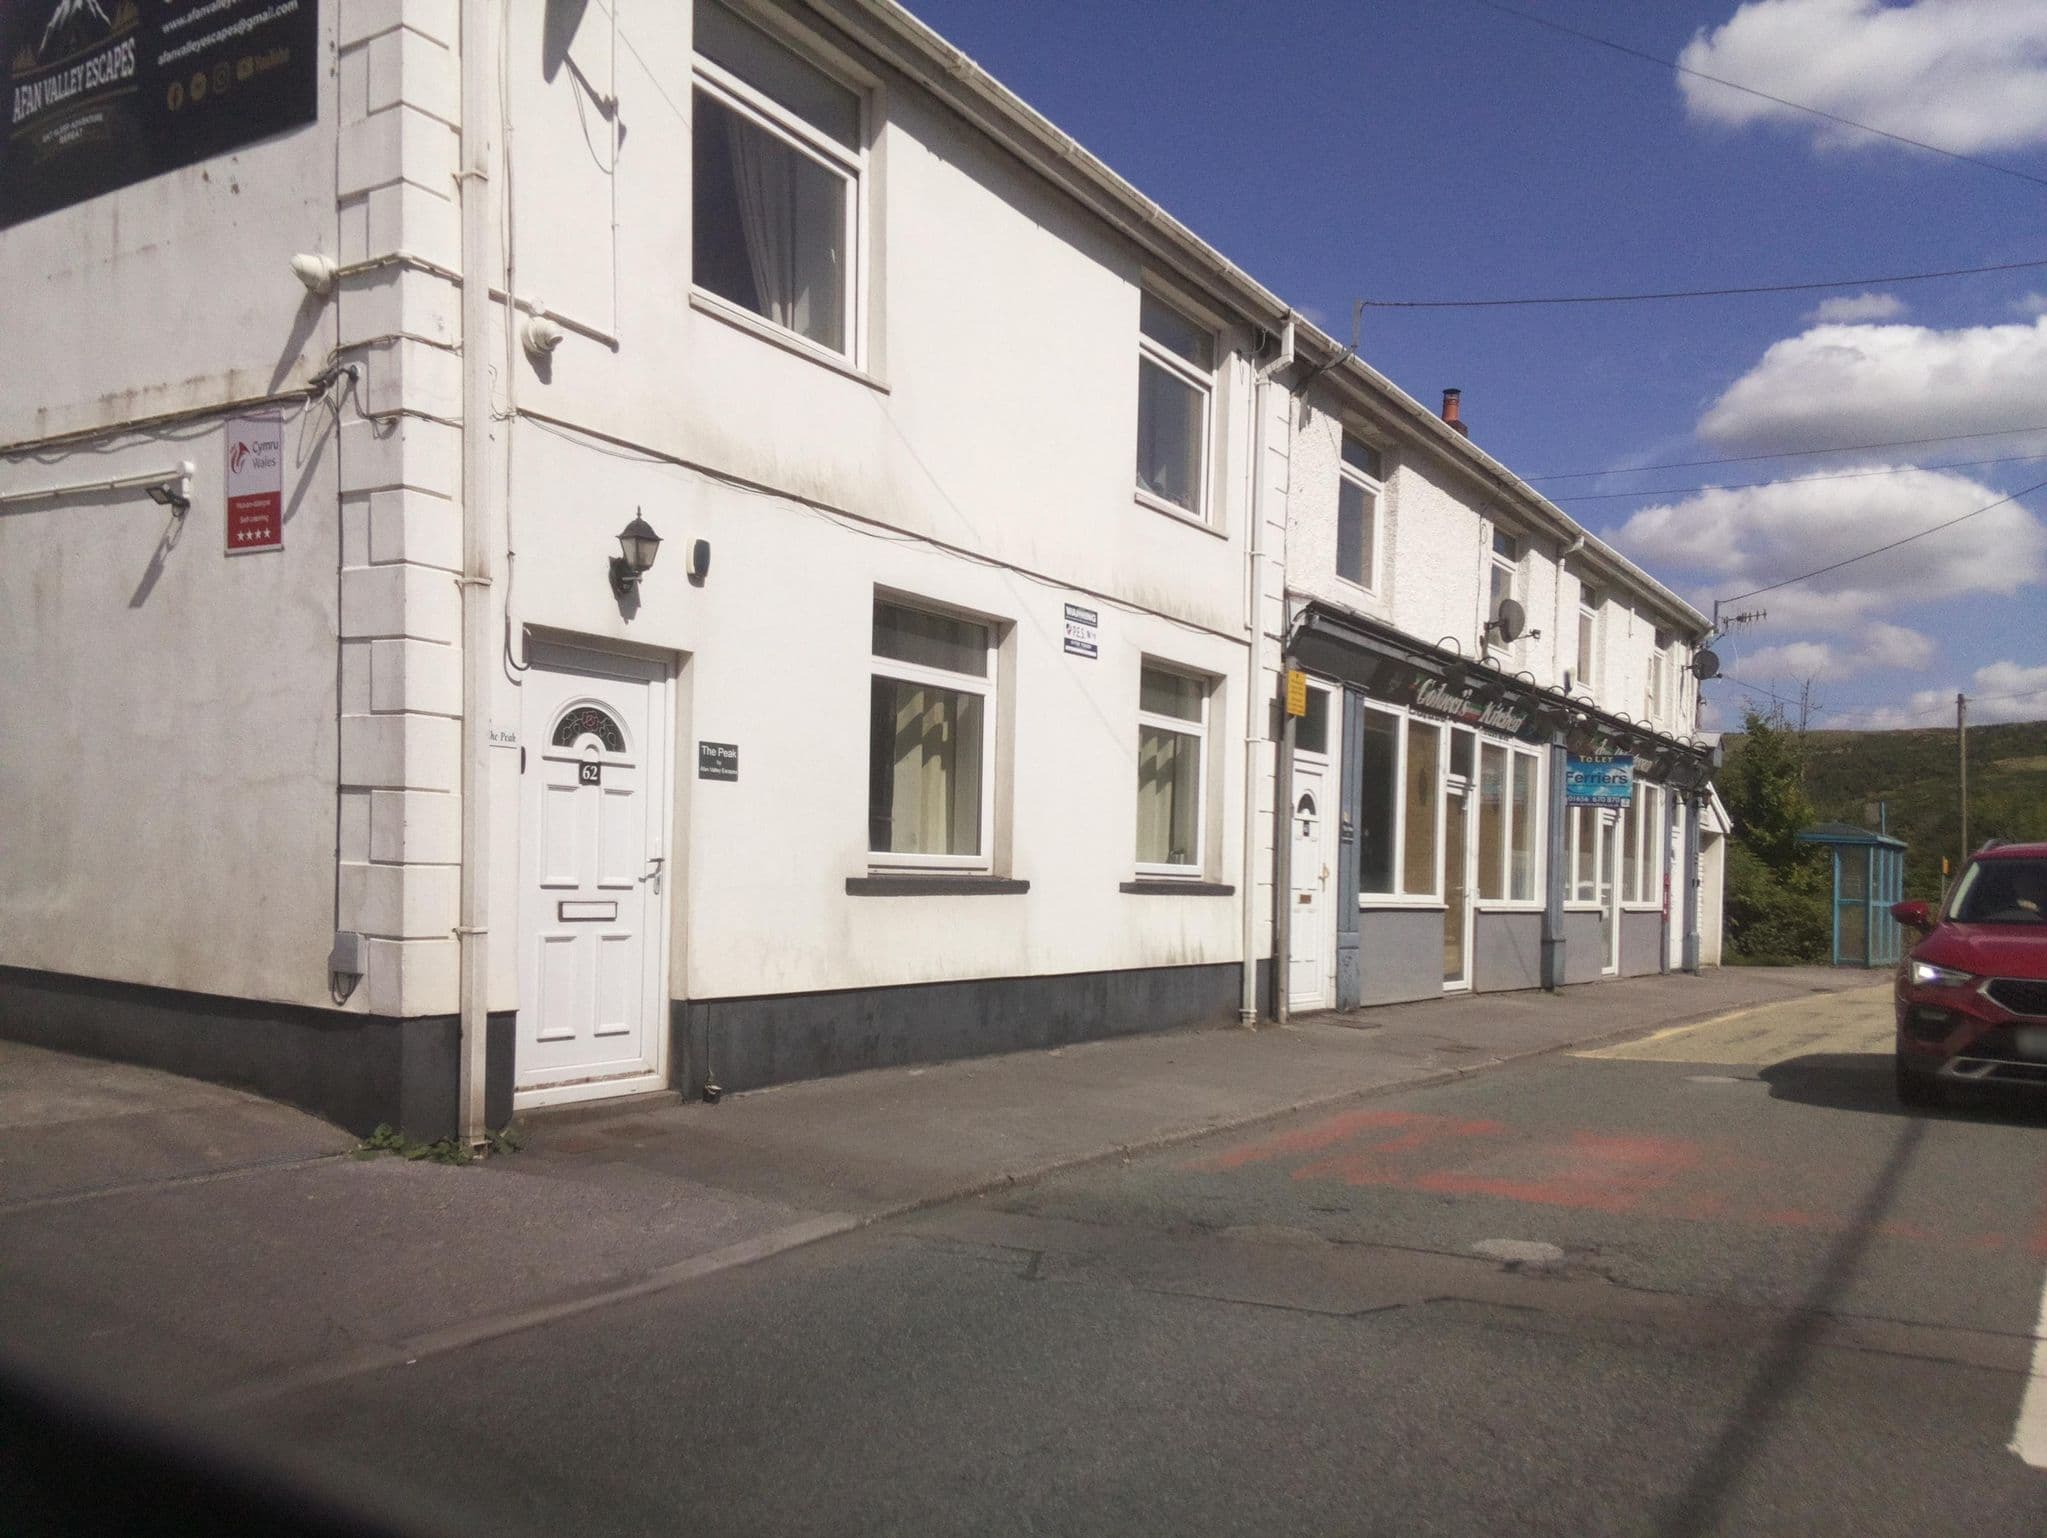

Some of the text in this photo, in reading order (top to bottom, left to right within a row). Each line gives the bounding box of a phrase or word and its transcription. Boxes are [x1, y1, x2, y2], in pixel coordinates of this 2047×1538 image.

[12, 37, 136, 123] AFAN VALLEY ESCAPES
[252, 440, 279, 456] Cymru
[252, 457, 276, 469] Wales
[1478, 701, 1528, 733] Kitchen
[500, 732, 516, 743] Peak
[701, 745, 737, 758] The Peak
[1579, 755, 1613, 763] TO LET
[582, 765, 599, 781] 62
[1566, 771, 1628, 784] Ferriers
